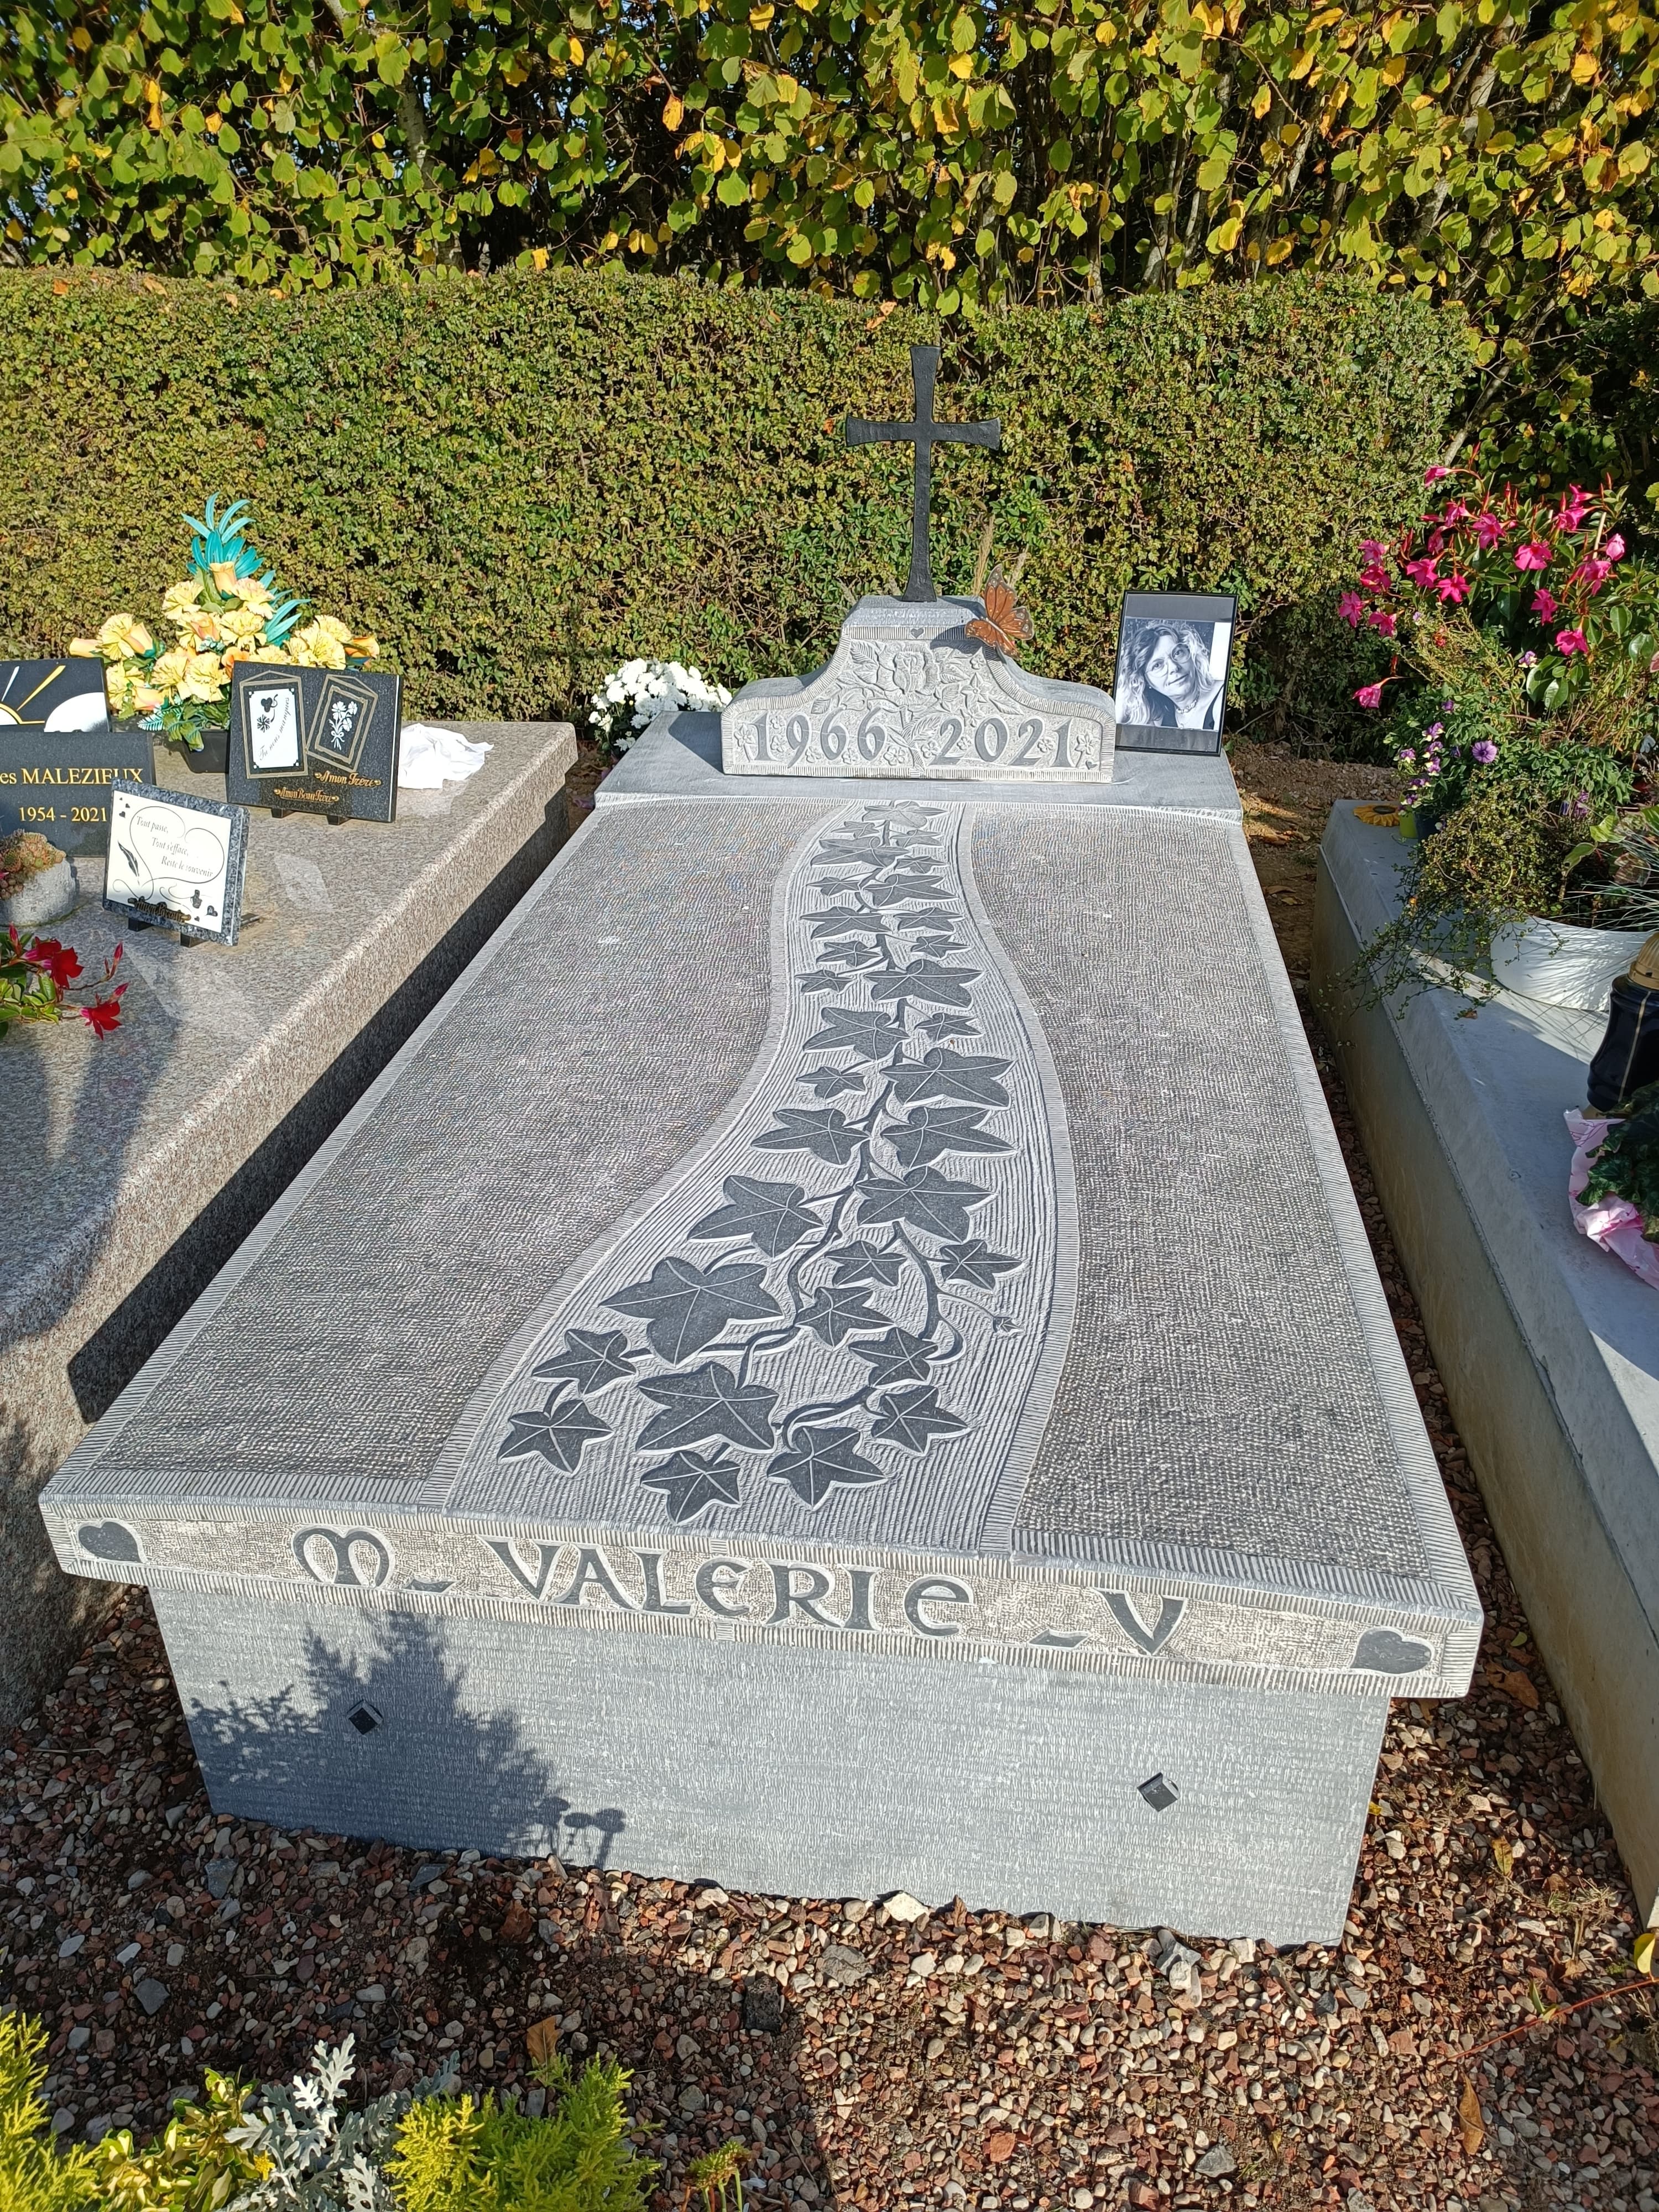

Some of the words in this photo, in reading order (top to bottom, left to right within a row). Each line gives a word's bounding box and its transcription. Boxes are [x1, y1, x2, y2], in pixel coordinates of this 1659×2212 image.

[748, 707, 885, 768] 1966
[927, 718, 1076, 768] 2021
[19, 807, 55, 822] 1954
[71, 807, 107, 822] 2021
[137, 816, 150, 828] Tout
[150, 822, 169, 833] passe,
[152, 837, 166, 849] Tout
[161, 855, 178, 868] Reste
[179, 860, 185, 870] le
[185, 865, 213, 877] souvenir
[1094, 1588, 1186, 1655] V
